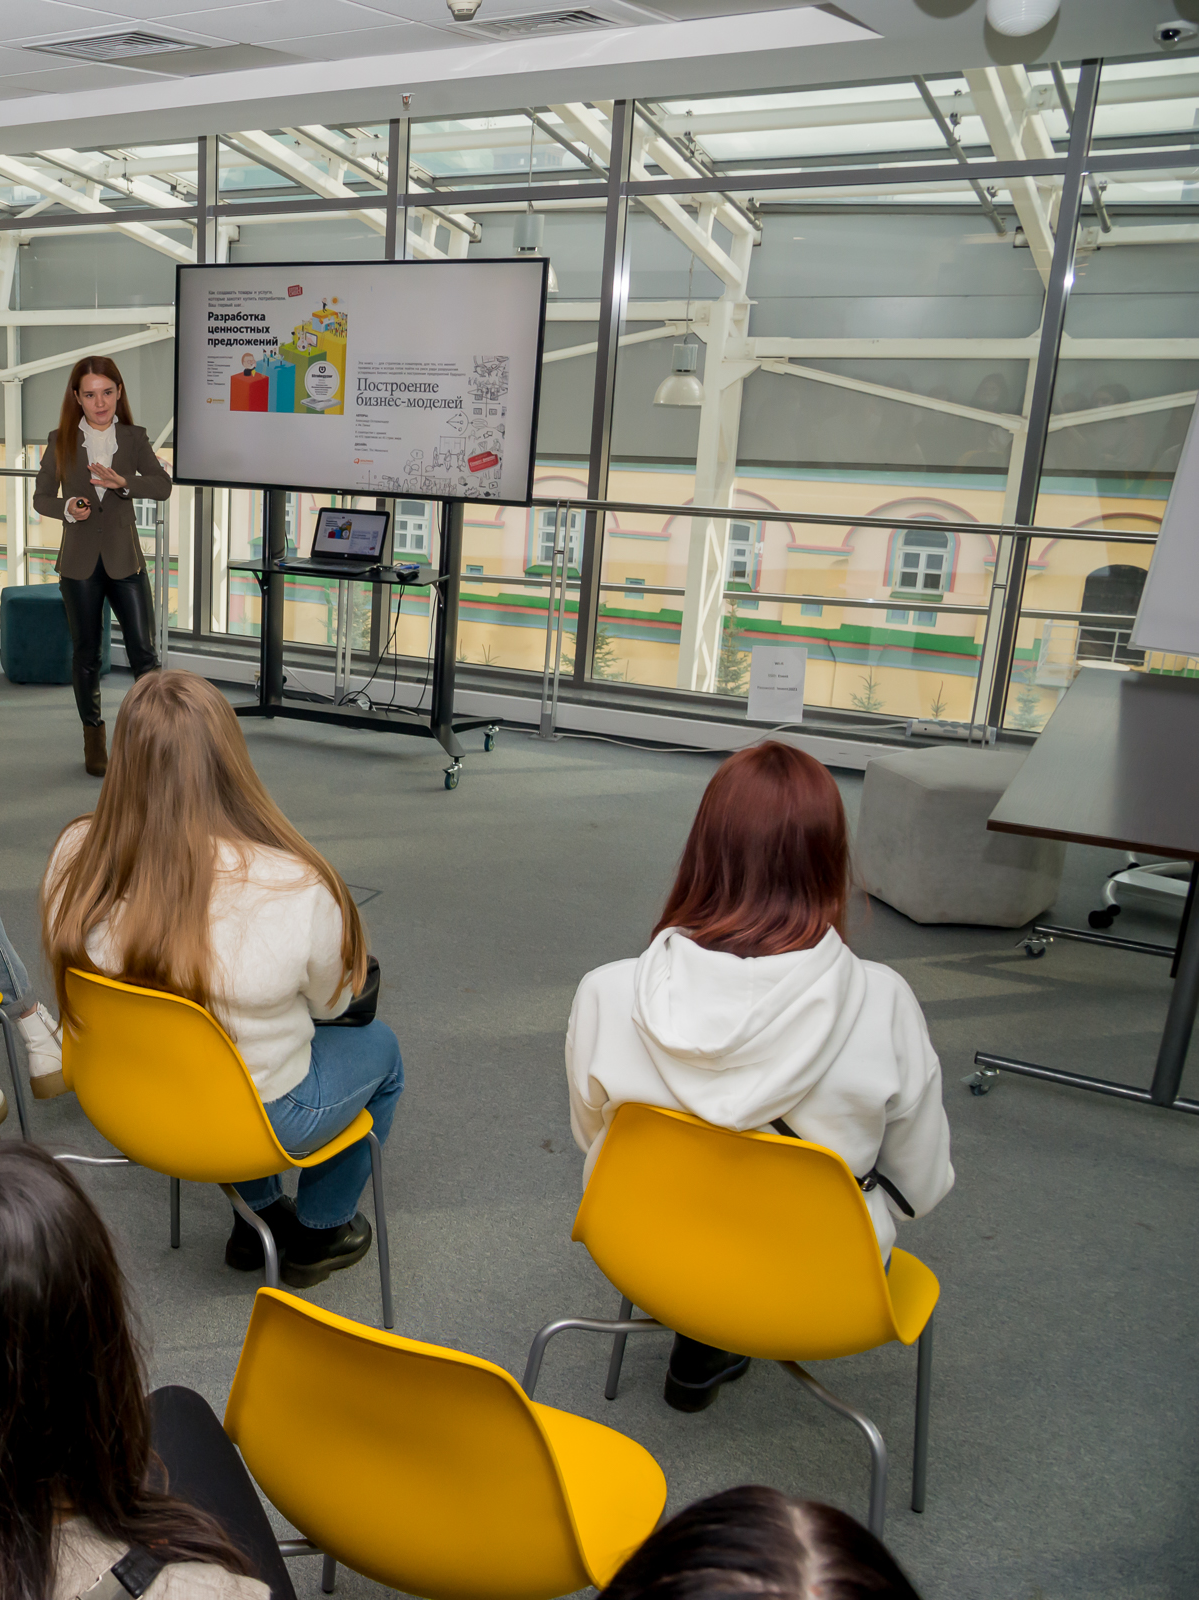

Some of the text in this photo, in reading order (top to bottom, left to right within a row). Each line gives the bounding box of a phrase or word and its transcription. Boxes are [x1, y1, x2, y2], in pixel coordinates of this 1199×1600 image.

[208, 311, 266, 323] Разработка
[208, 325, 270, 335] ценностных
[207, 336, 279, 348] предложений
[357, 377, 439, 396] Построение
[356, 392, 463, 410] бизнес-моделей
